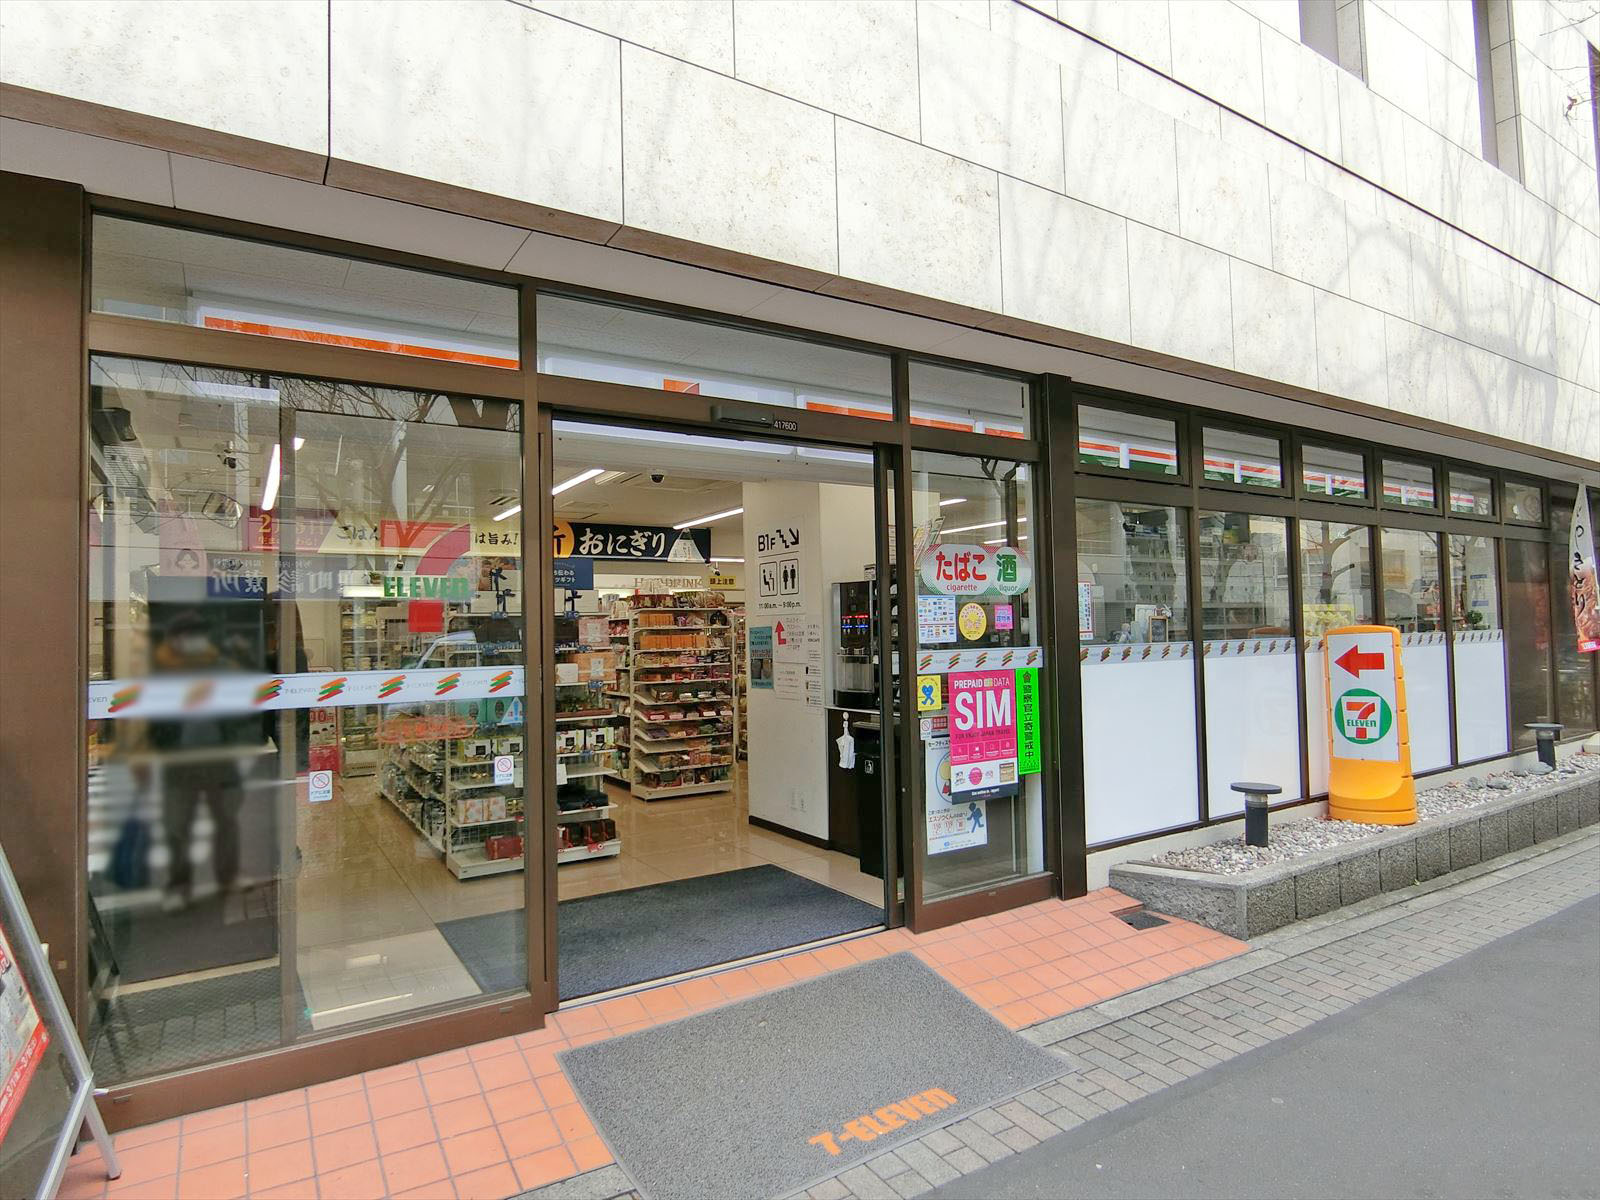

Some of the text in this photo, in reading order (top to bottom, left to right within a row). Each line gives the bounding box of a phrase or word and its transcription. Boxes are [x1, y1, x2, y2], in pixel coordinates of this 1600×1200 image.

[774, 420, 797, 431] 417600
[579, 527, 666, 557] おにぎり
[757, 534, 776, 553] B1F
[936, 551, 1017, 583] たばこ 酒
[946, 584, 1019, 592] cigarette liquor
[954, 676, 1010, 690] PREPAID DATA
[954, 688, 1011, 731] SIM
